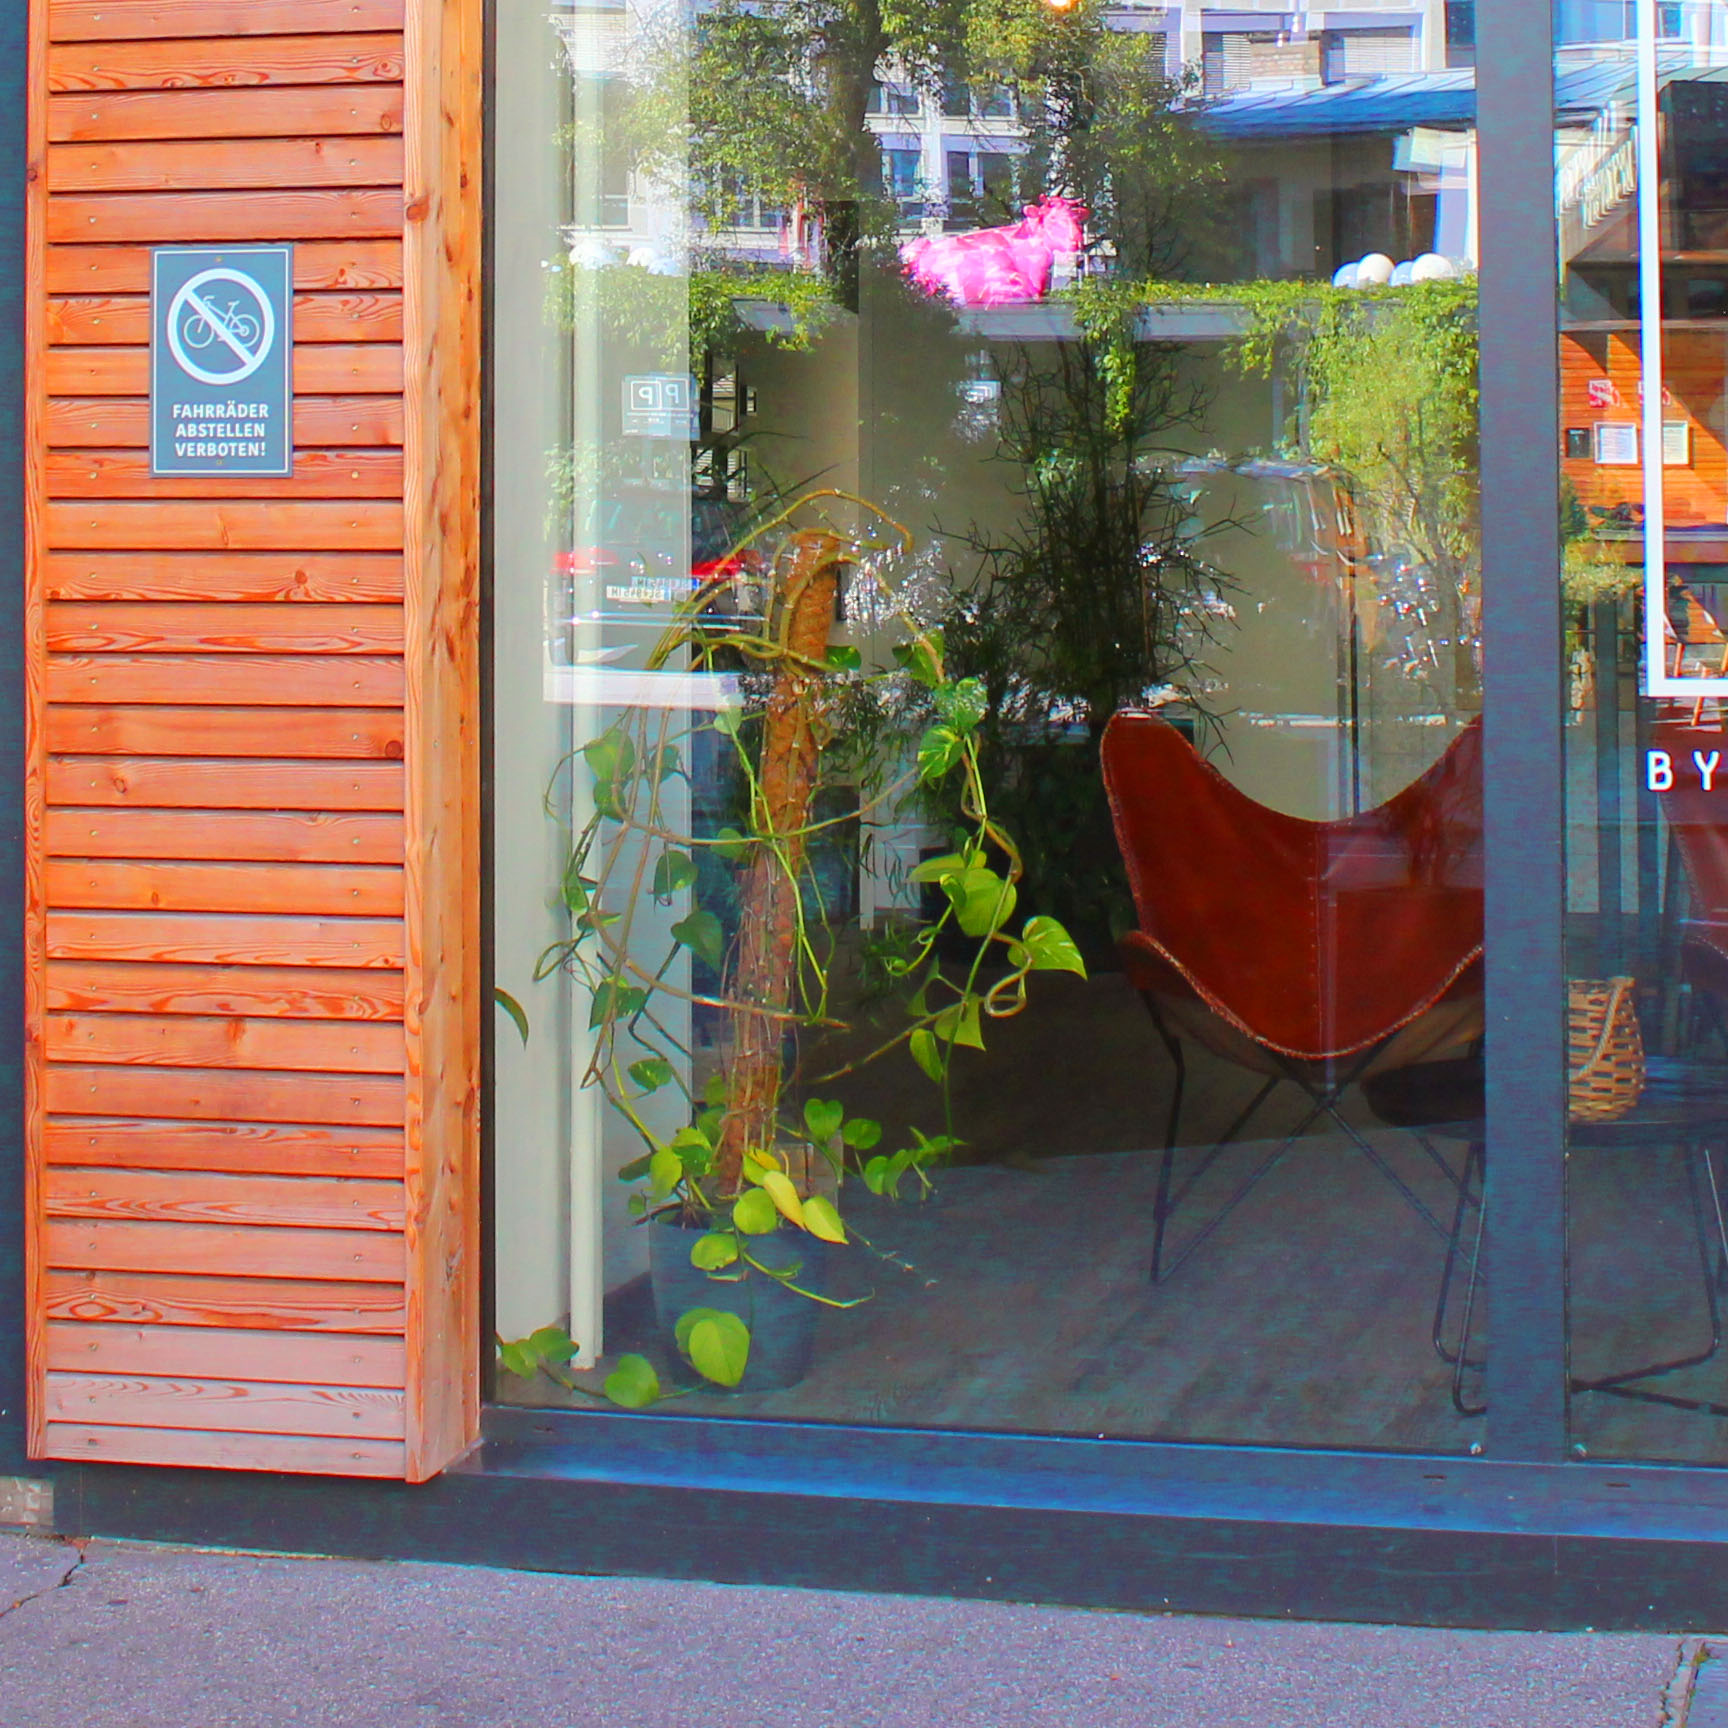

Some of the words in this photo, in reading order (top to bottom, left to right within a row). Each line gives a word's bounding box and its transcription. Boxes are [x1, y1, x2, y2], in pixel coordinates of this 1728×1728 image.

[172, 400, 270, 419] FAHRRÄDER
[175, 423, 266, 438] ABSTELLEN
[175, 442, 266, 457] VERBOTEN!
[1646, 749, 1720, 793] BY
